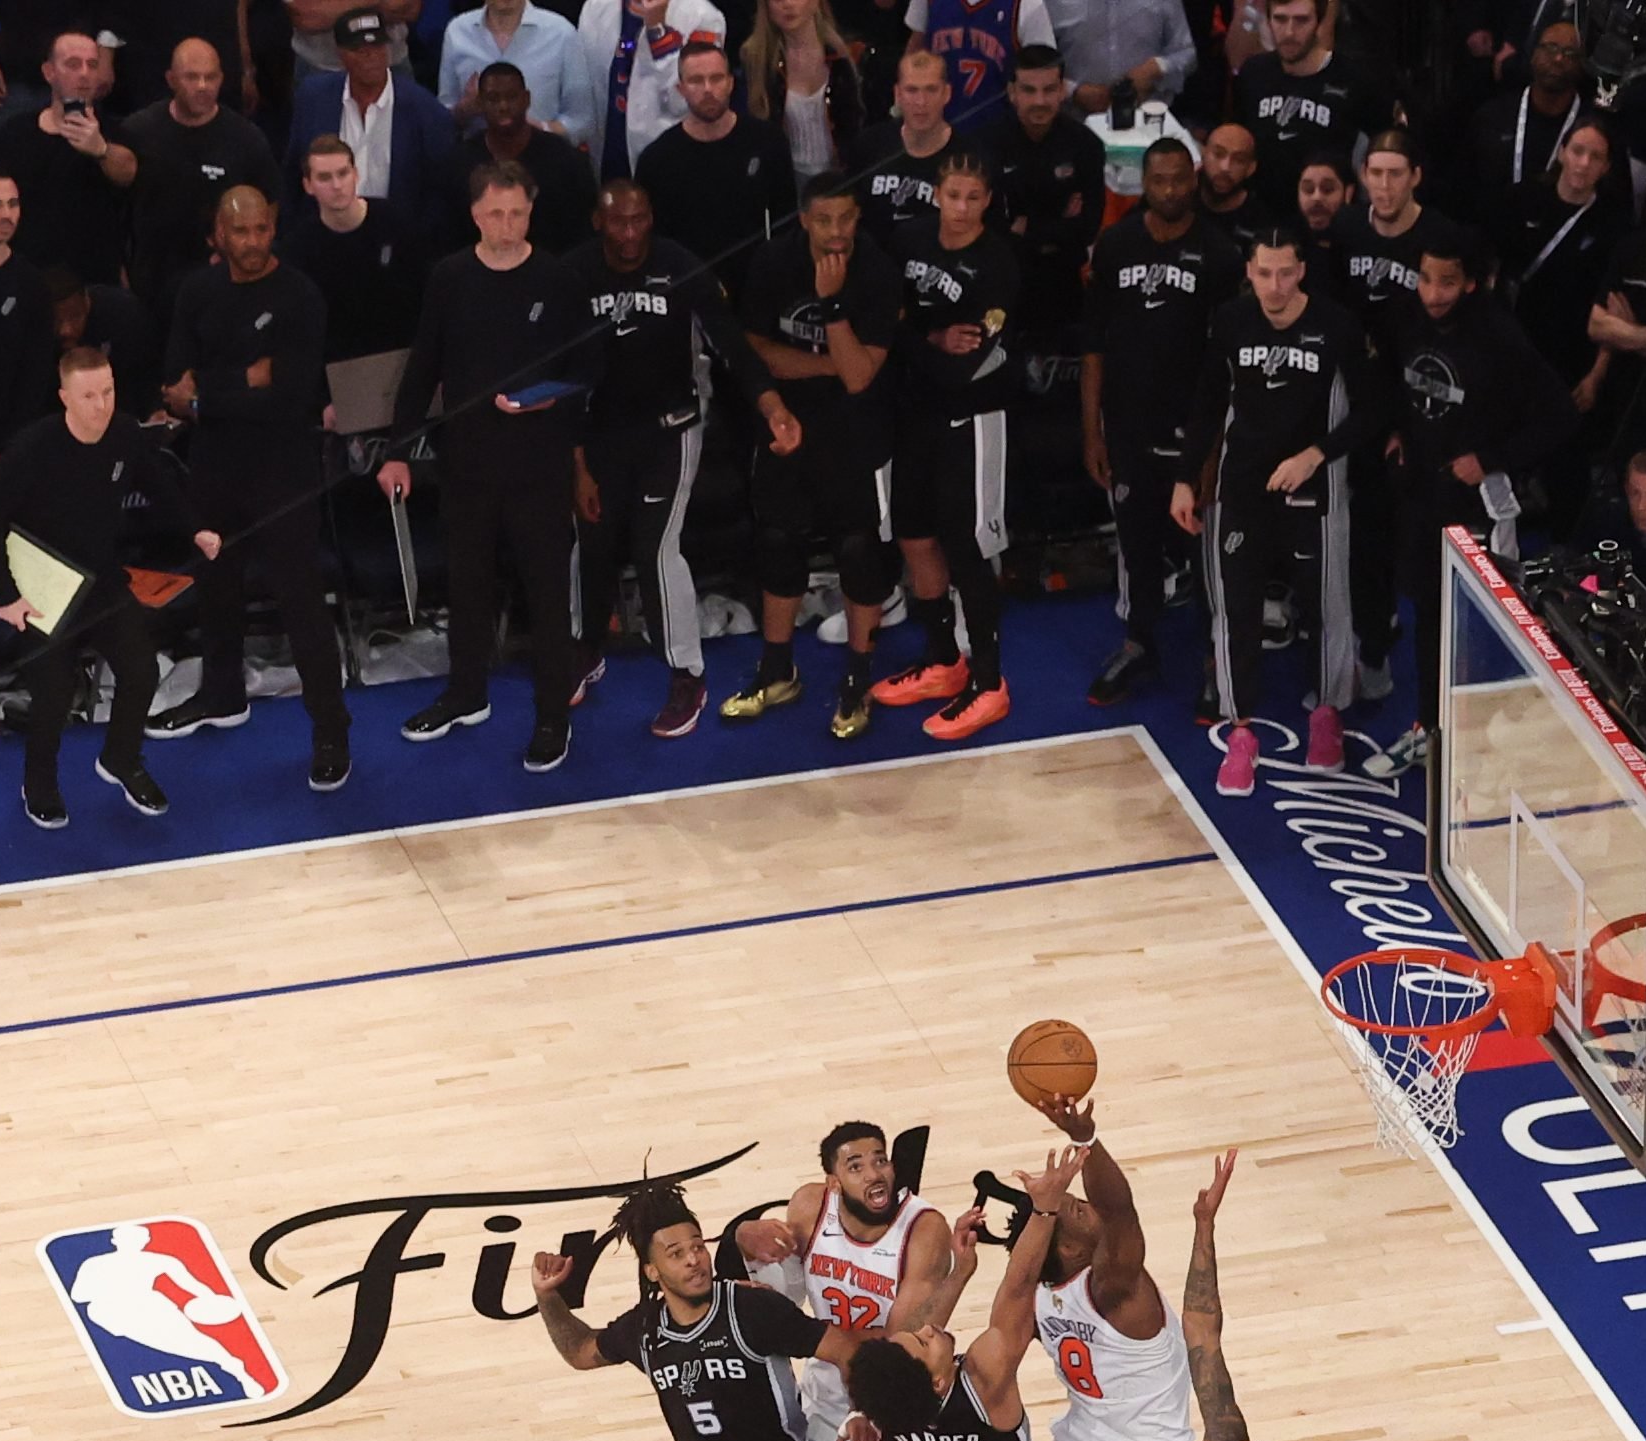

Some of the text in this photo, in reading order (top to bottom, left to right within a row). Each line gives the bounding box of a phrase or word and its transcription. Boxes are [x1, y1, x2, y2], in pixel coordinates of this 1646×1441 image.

[958, 59, 986, 97] 7
[872, 175, 941, 208] SPUR
[1208, 716, 1487, 998] Michel
[810, 1253, 897, 1301] NEW YORK
[822, 1285, 885, 1331] 32
[130, 1364, 222, 1407] NBA
[1058, 1336, 1104, 1399] 8
[686, 1400, 723, 1435] 5
